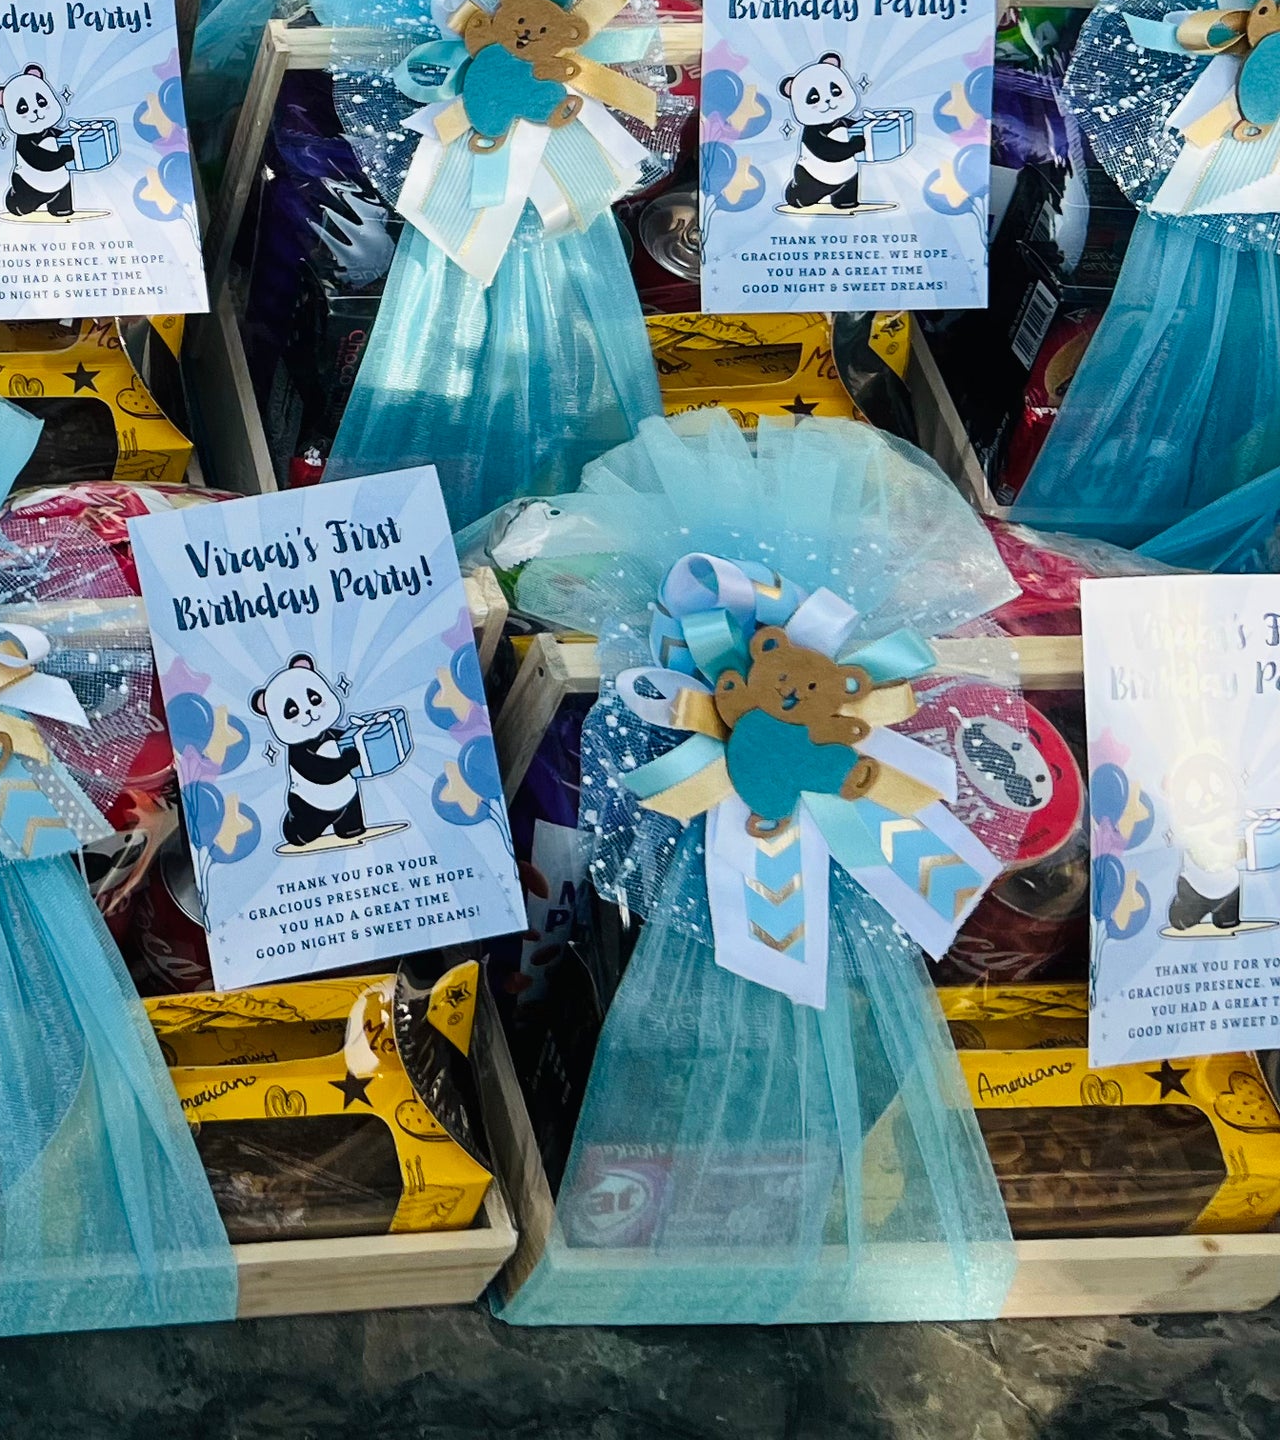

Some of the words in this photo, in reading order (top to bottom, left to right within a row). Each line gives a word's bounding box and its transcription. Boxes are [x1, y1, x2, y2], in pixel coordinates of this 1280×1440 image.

[184, 527, 318, 578] Viraaj's
[326, 517, 402, 553] First
[172, 582, 320, 631] Birthday
[330, 555, 432, 602] Party!
[978, 1062, 1076, 1102] Americano
